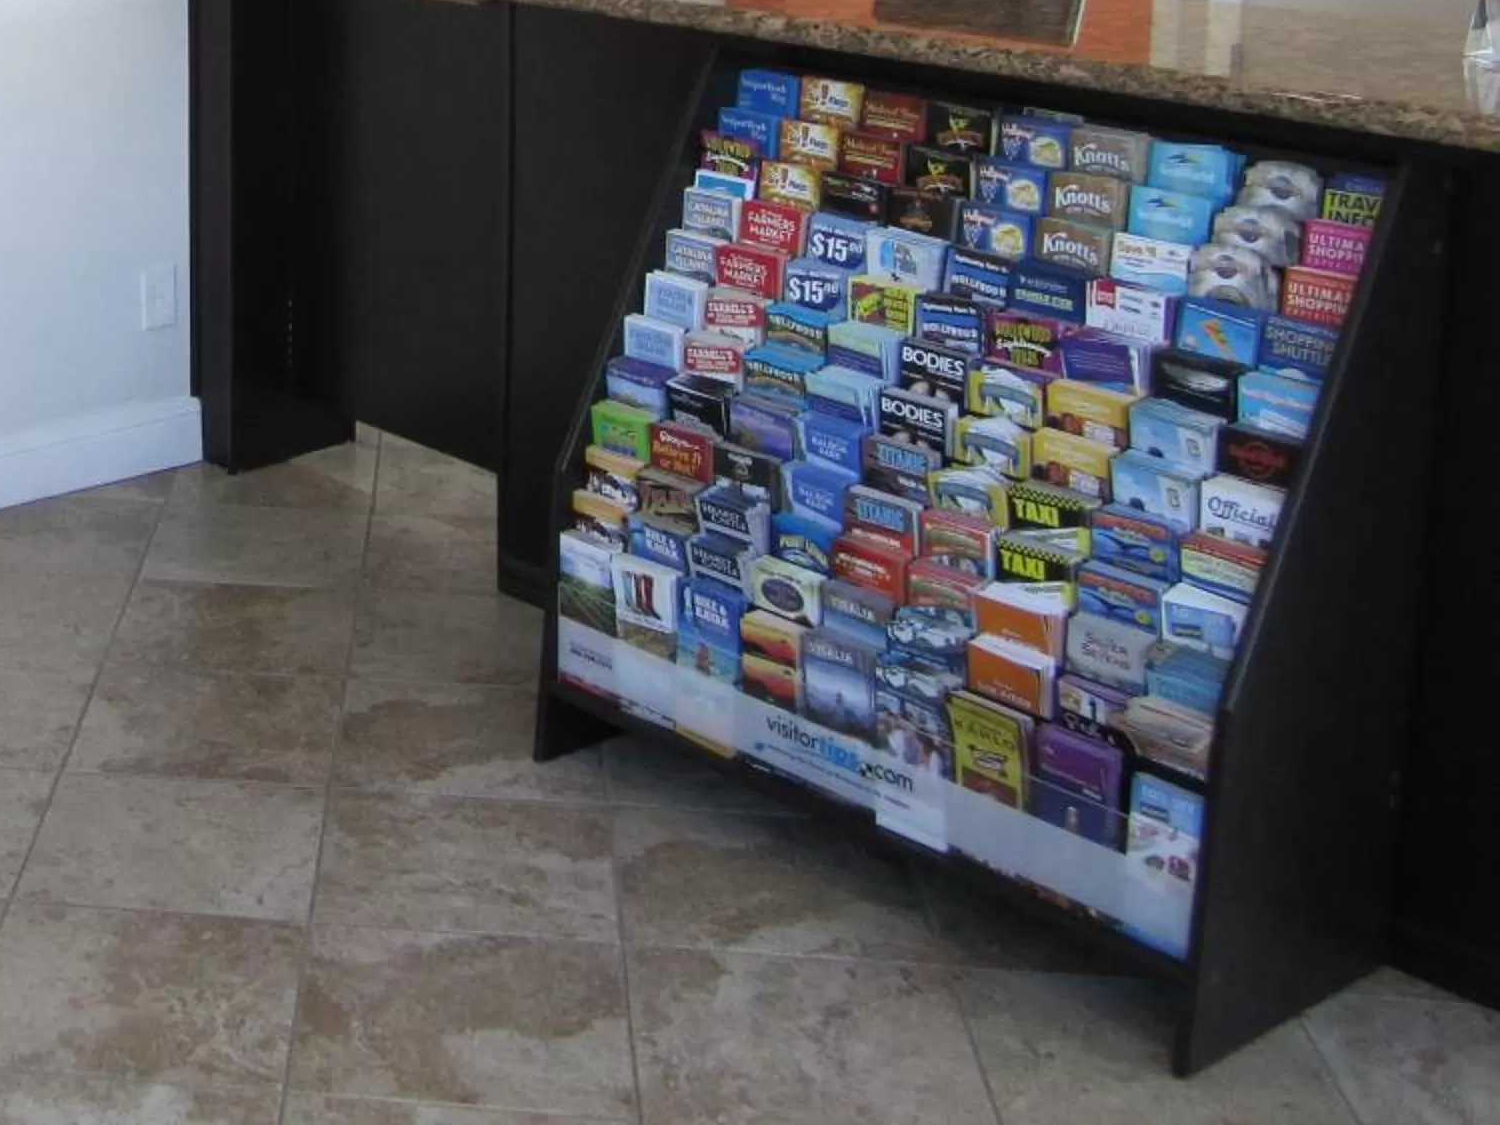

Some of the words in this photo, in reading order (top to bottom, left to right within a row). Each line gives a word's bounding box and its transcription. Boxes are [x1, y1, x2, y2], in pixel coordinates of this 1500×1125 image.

[1329, 192, 1382, 214] TRAV
[747, 212, 797, 232] FARMERS
[749, 224, 794, 244] MARKET
[1308, 232, 1365, 252] ULTIMA
[719, 256, 769, 276] FARMERS
[723, 267, 768, 286] MARKET
[902, 346, 966, 376] BODIES
[881, 397, 944, 428] BODIES
[1012, 497, 1060, 528] TAXI
[1207, 495, 1277, 527] Official
[999, 548, 1045, 581] TAXI
[764, 714, 915, 792] visitortips.com
